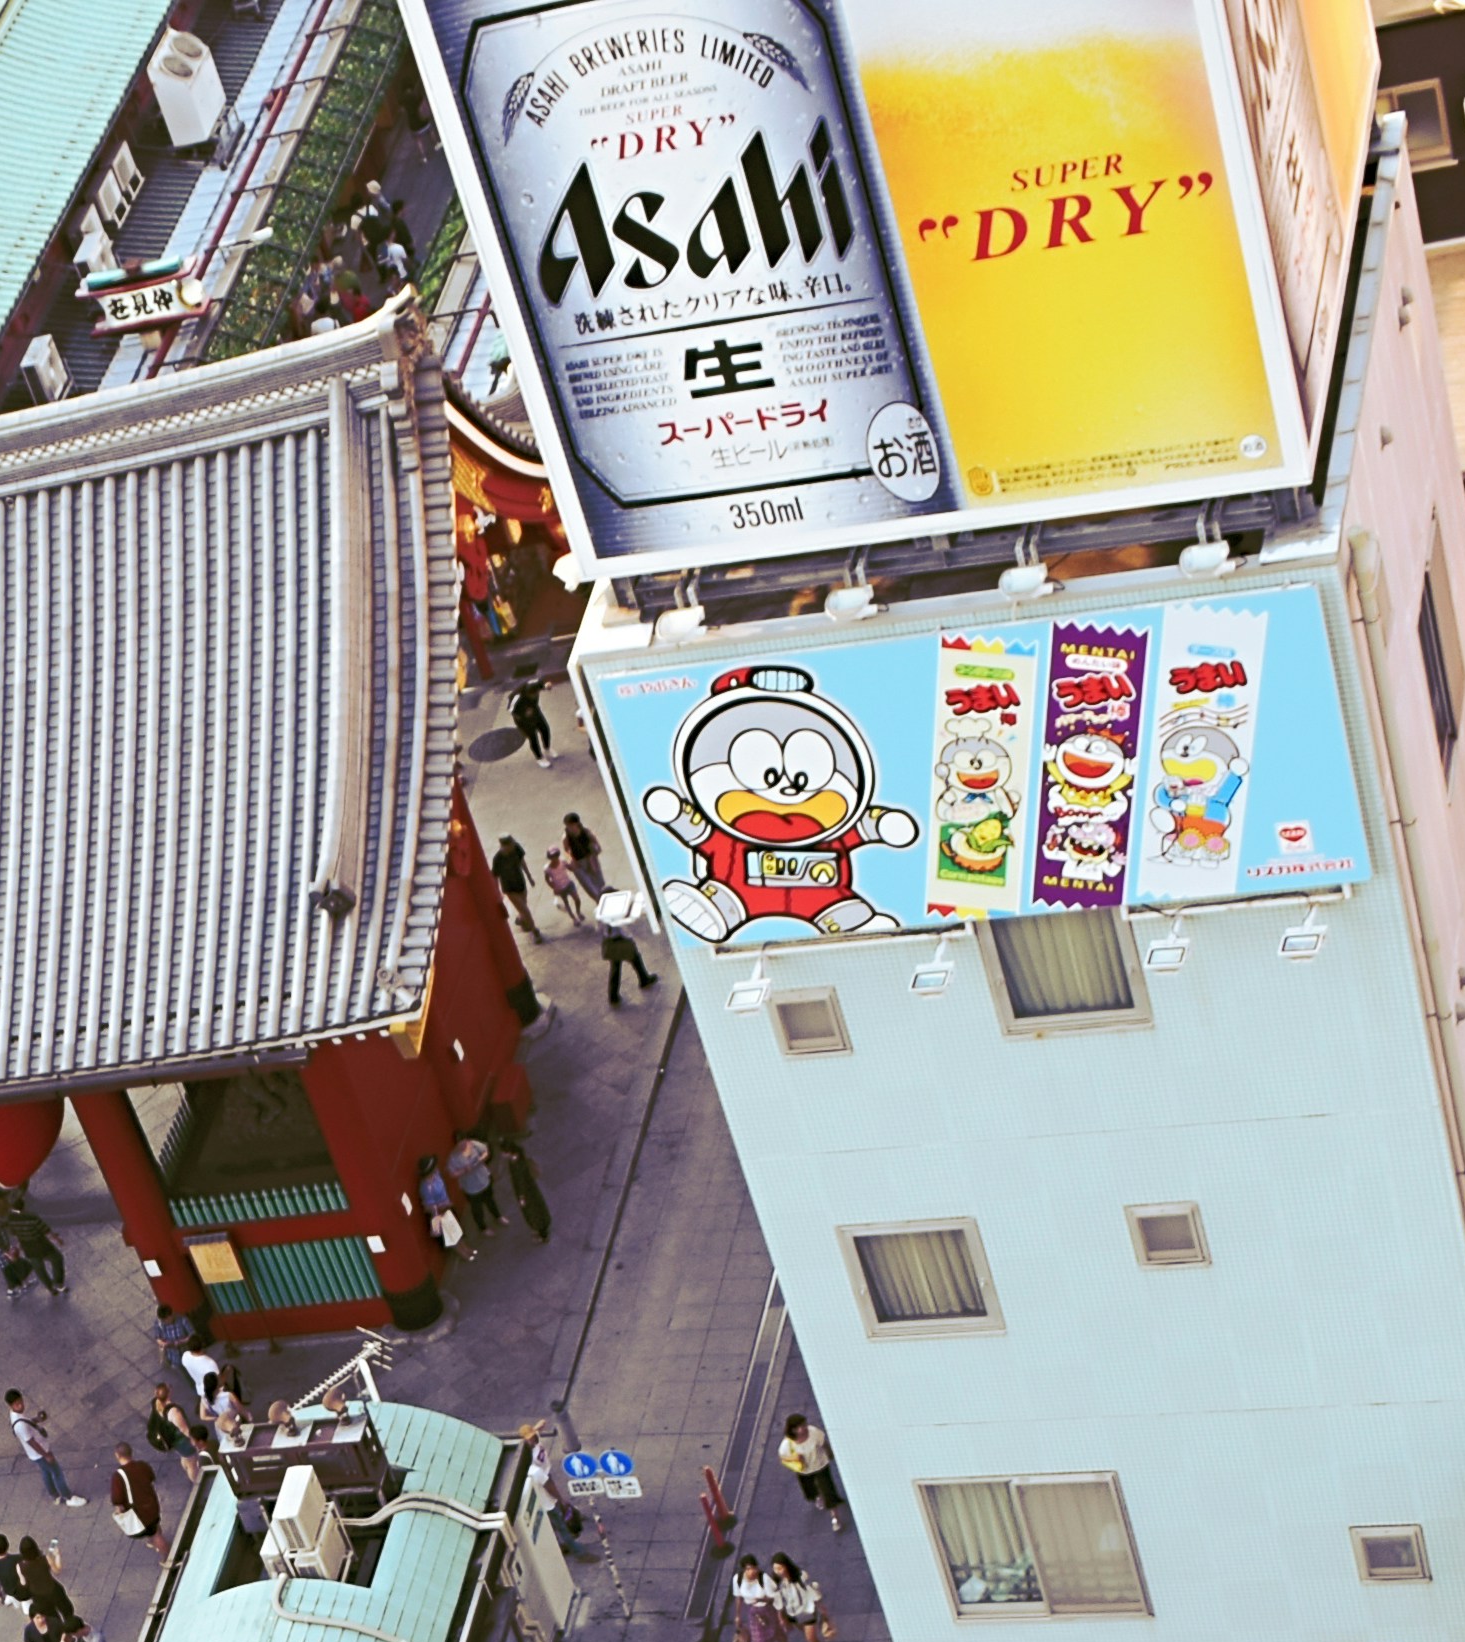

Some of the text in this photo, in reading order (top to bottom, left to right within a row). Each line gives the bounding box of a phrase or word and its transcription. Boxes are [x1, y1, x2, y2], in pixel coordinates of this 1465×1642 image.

[526, 28, 775, 128] ASAHI BREWERIES LIMITED
[617, 59, 663, 77] ASAHI
[600, 72, 689, 98] DRAFT BEER
[625, 104, 683, 125] SUPER
[1011, 153, 1123, 192] SUPER
[537, 117, 856, 306] Asahi
[684, 338, 776, 400] 生
[785, 355, 874, 375] SMOOTHNESS
[789, 374, 828, 388] ASAHI
[658, 398, 829, 446] スーパードライ
[711, 439, 789, 470] 生ビール
[873, 429, 938, 478] お酒
[729, 496, 804, 530] 350ml
[1060, 643, 1135, 660] MENTAI
[1056, 675, 1133, 708] うまい
[1169, 660, 1247, 694] うまい
[945, 682, 1021, 716] うまい
[1042, 875, 1114, 892] MENTAI
